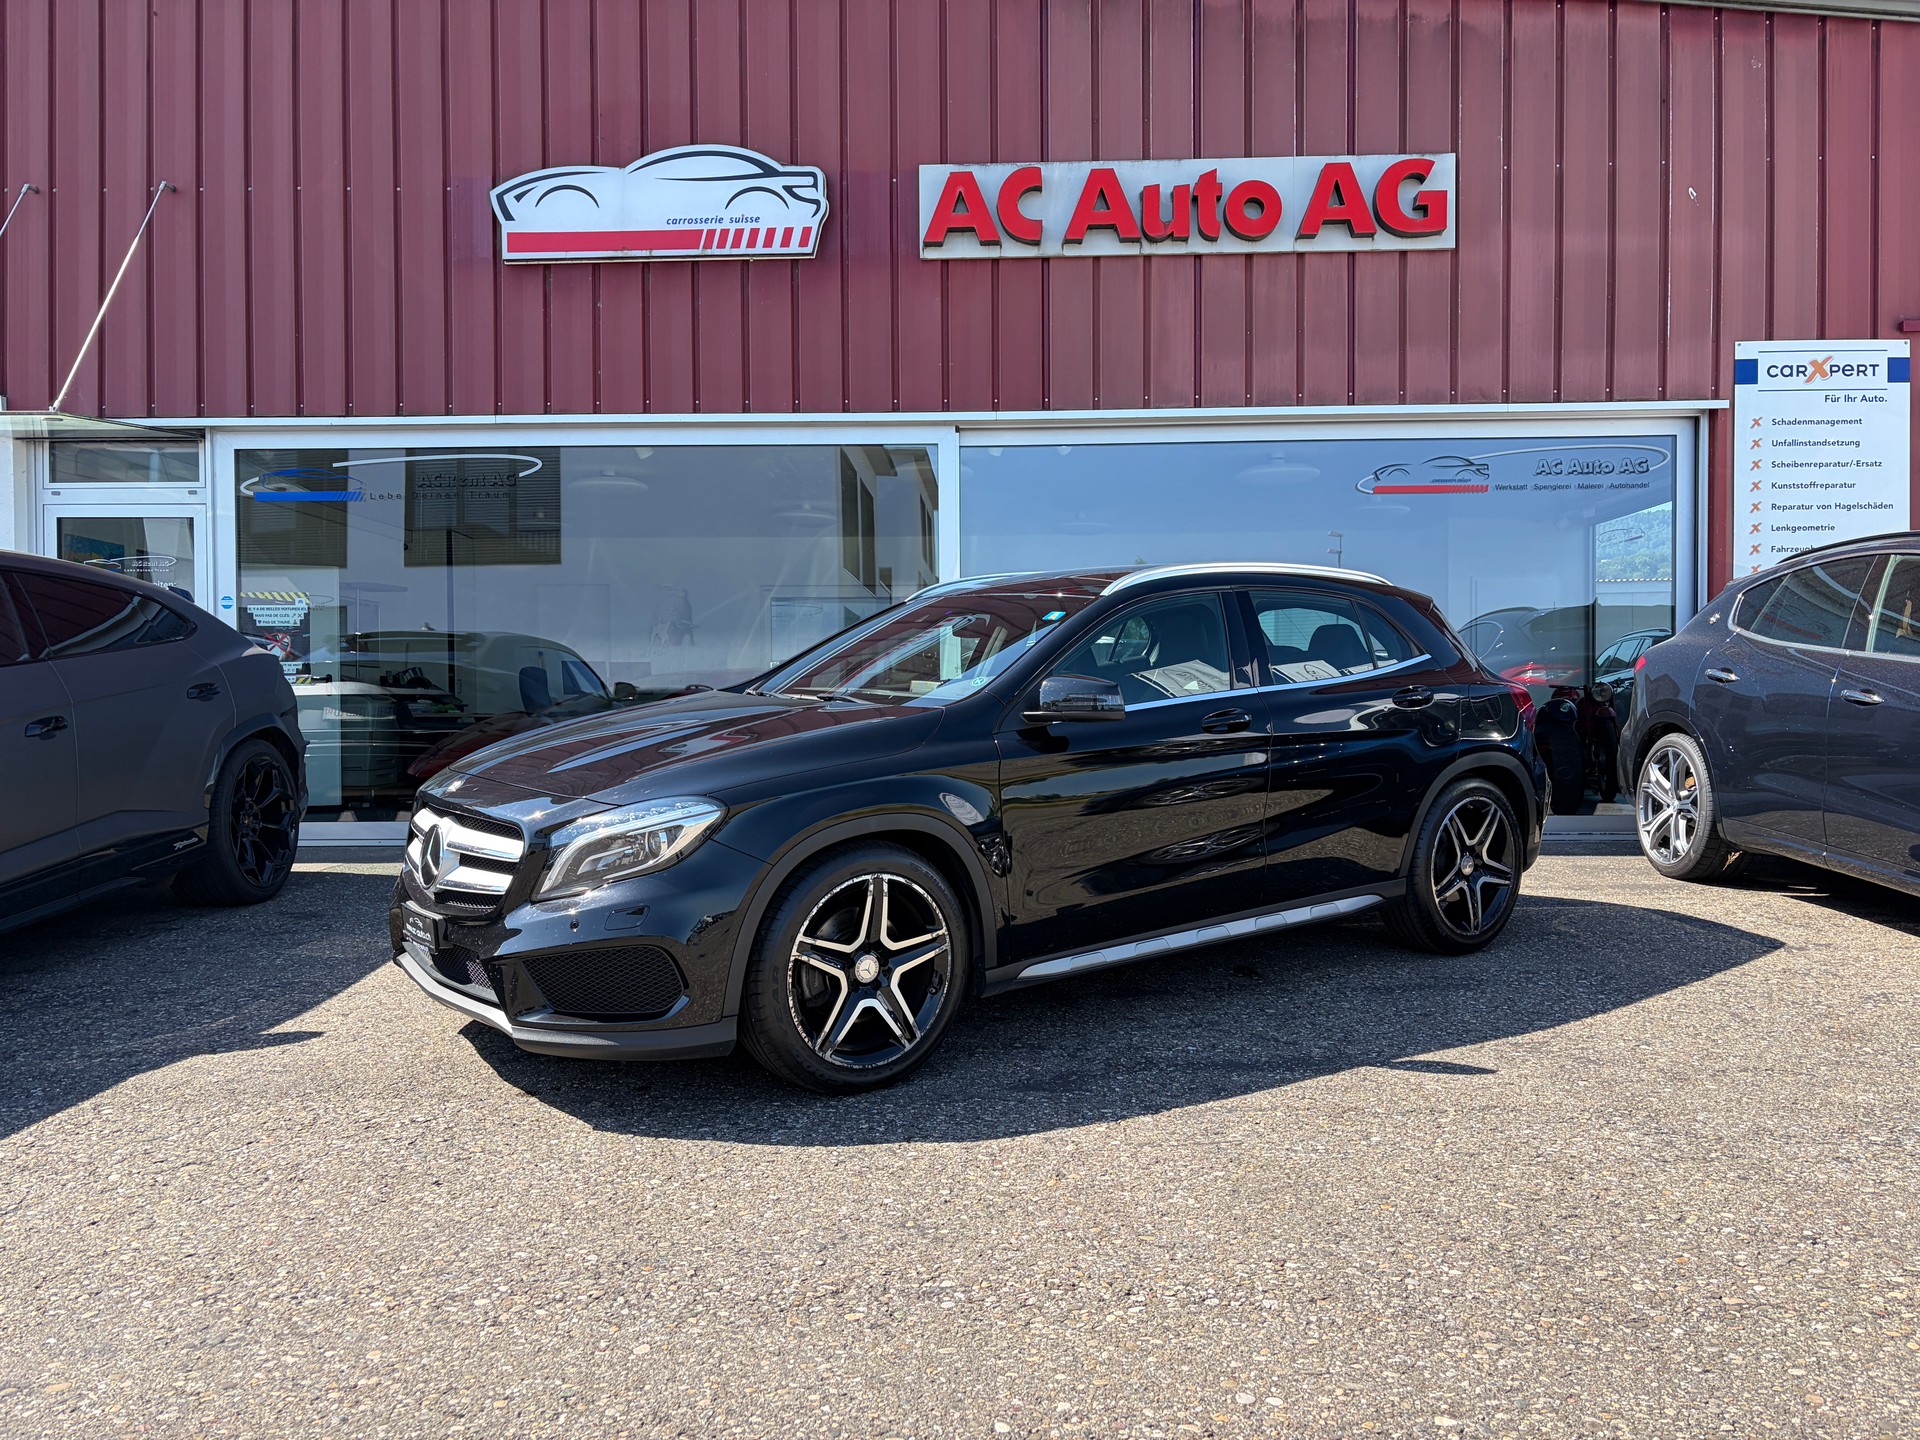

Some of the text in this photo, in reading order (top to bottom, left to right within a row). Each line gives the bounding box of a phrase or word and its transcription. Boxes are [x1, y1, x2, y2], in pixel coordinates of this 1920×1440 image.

[922, 158, 1448, 248] AC Auto AG
[666, 214, 760, 225] carrosserie suisse
[1824, 393, 1888, 403] Für Ihr Auto.
[1771, 417, 1863, 427] Schadenmanagement
[1771, 439, 1861, 448] Unfallinstandsetzung
[1534, 456, 1650, 475] AC Auto AG
[1771, 460, 1883, 469] Scheibenreparatur/-Ersatz
[417, 472, 443, 488] AC
[489, 471, 517, 487] AG
[1533, 484, 1572, 492] Spenglerei
[1609, 482, 1650, 490] Autohandel
[1771, 481, 1857, 490] Kunststoffreparatur
[369, 492, 402, 500] Lebe
[1771, 503, 1813, 512] Reparatur
[1834, 502, 1894, 512] Hagelschäden
[1771, 524, 1836, 533] Lenkgeometrie
